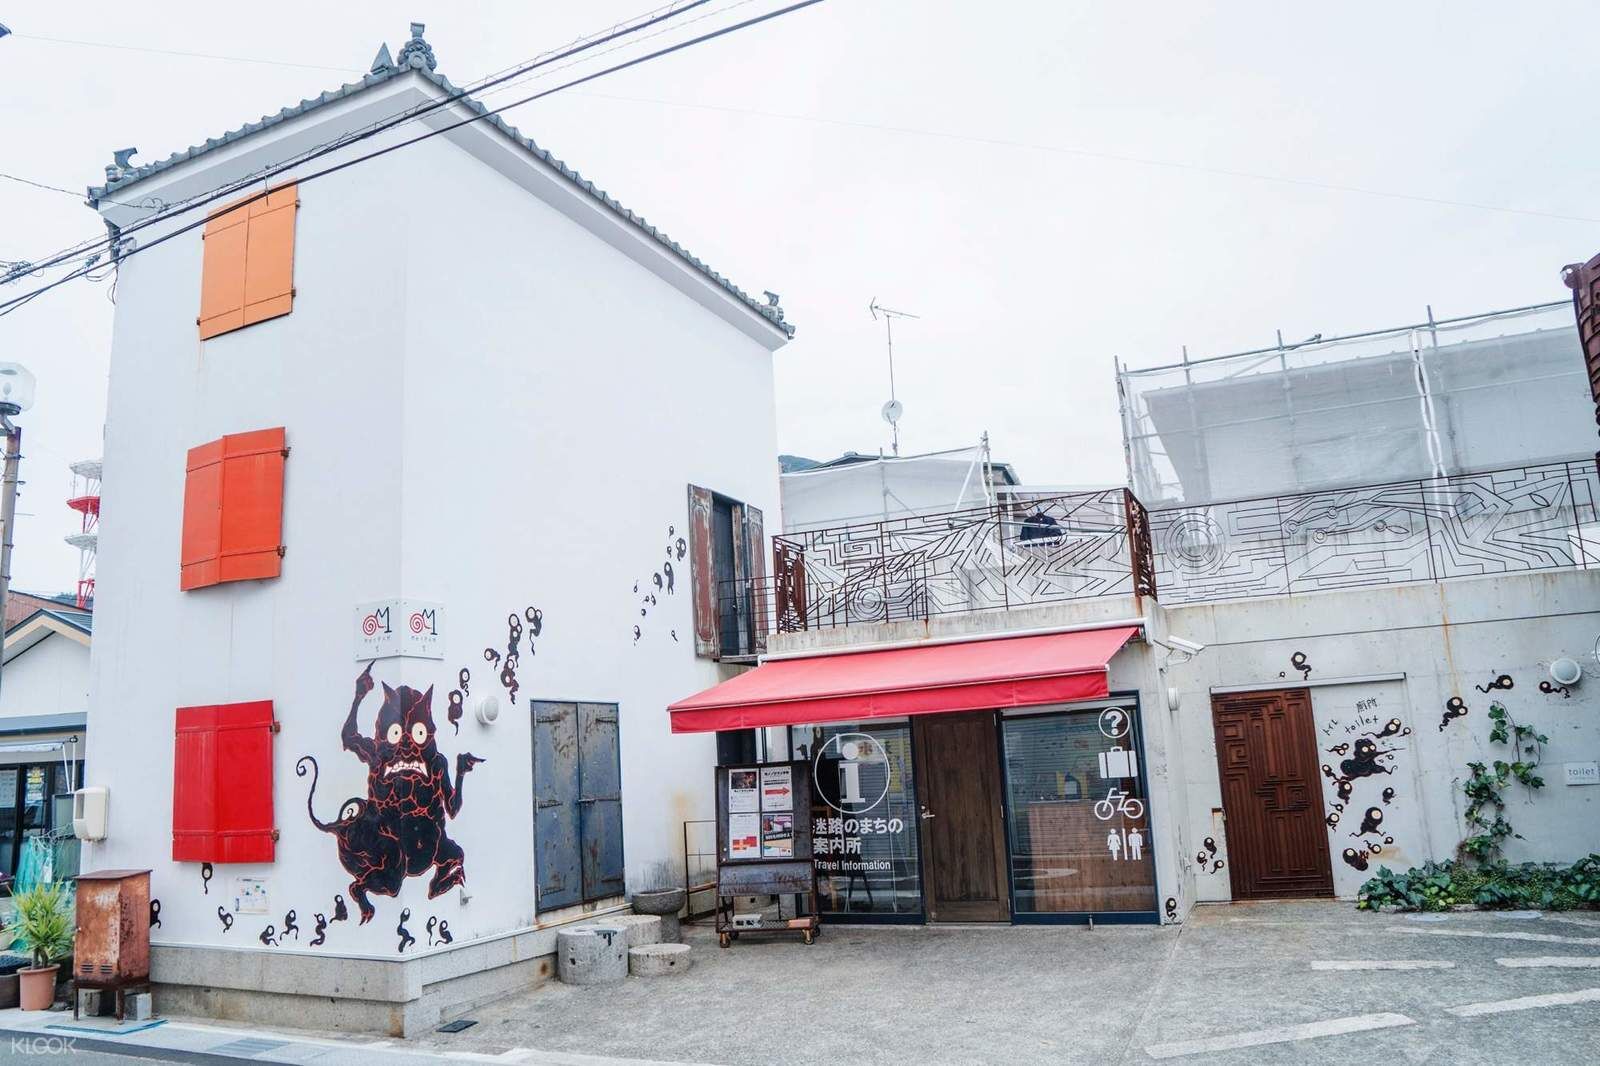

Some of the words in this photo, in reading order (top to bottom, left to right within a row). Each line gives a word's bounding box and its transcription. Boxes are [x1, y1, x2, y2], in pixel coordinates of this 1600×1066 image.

[1345, 715, 1379, 734] toilet
[812, 817, 904, 835] 迷路のまちの
[812, 837, 862, 855] 案内所
[814, 859, 839, 870] Travel
[842, 860, 891, 871] Information
